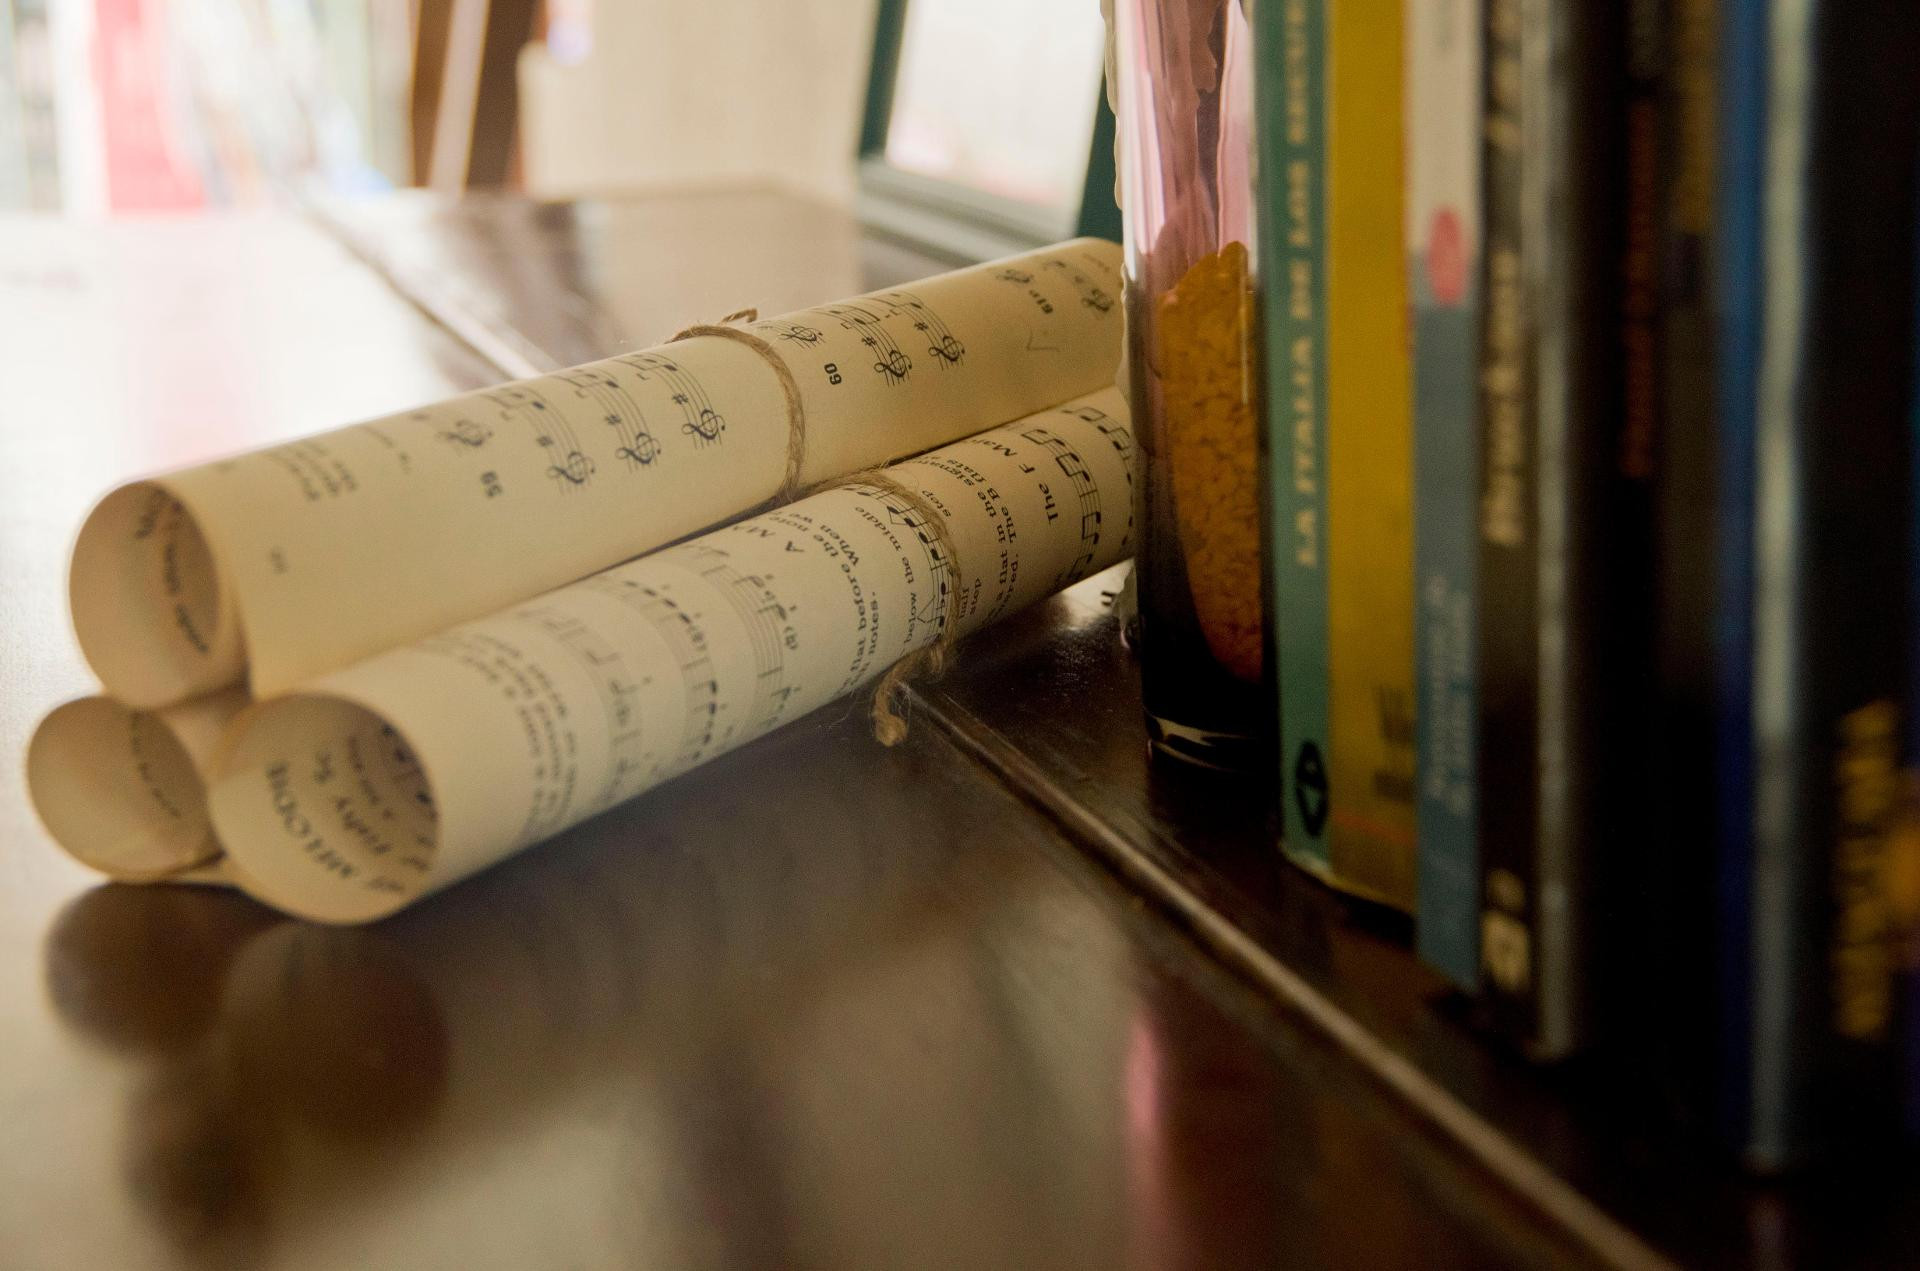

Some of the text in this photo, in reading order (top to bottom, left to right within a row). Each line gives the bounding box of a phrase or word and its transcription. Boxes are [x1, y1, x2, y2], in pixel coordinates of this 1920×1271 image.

[824, 363, 842, 385] 60
[947, 459, 987, 483] flats
[1019, 464, 1036, 474] F
[977, 491, 998, 519] the
[987, 487, 1000, 501] B
[1039, 482, 1059, 526] The
[996, 524, 1006, 544] in
[1001, 505, 1018, 545] The
[813, 533, 840, 558] the
[819, 524, 860, 567] When
[855, 505, 918, 644] below the middle
[999, 549, 1009, 585] flat
[841, 562, 867, 632] before
[867, 591, 880, 656] notes.
[850, 636, 867, 672] flat
